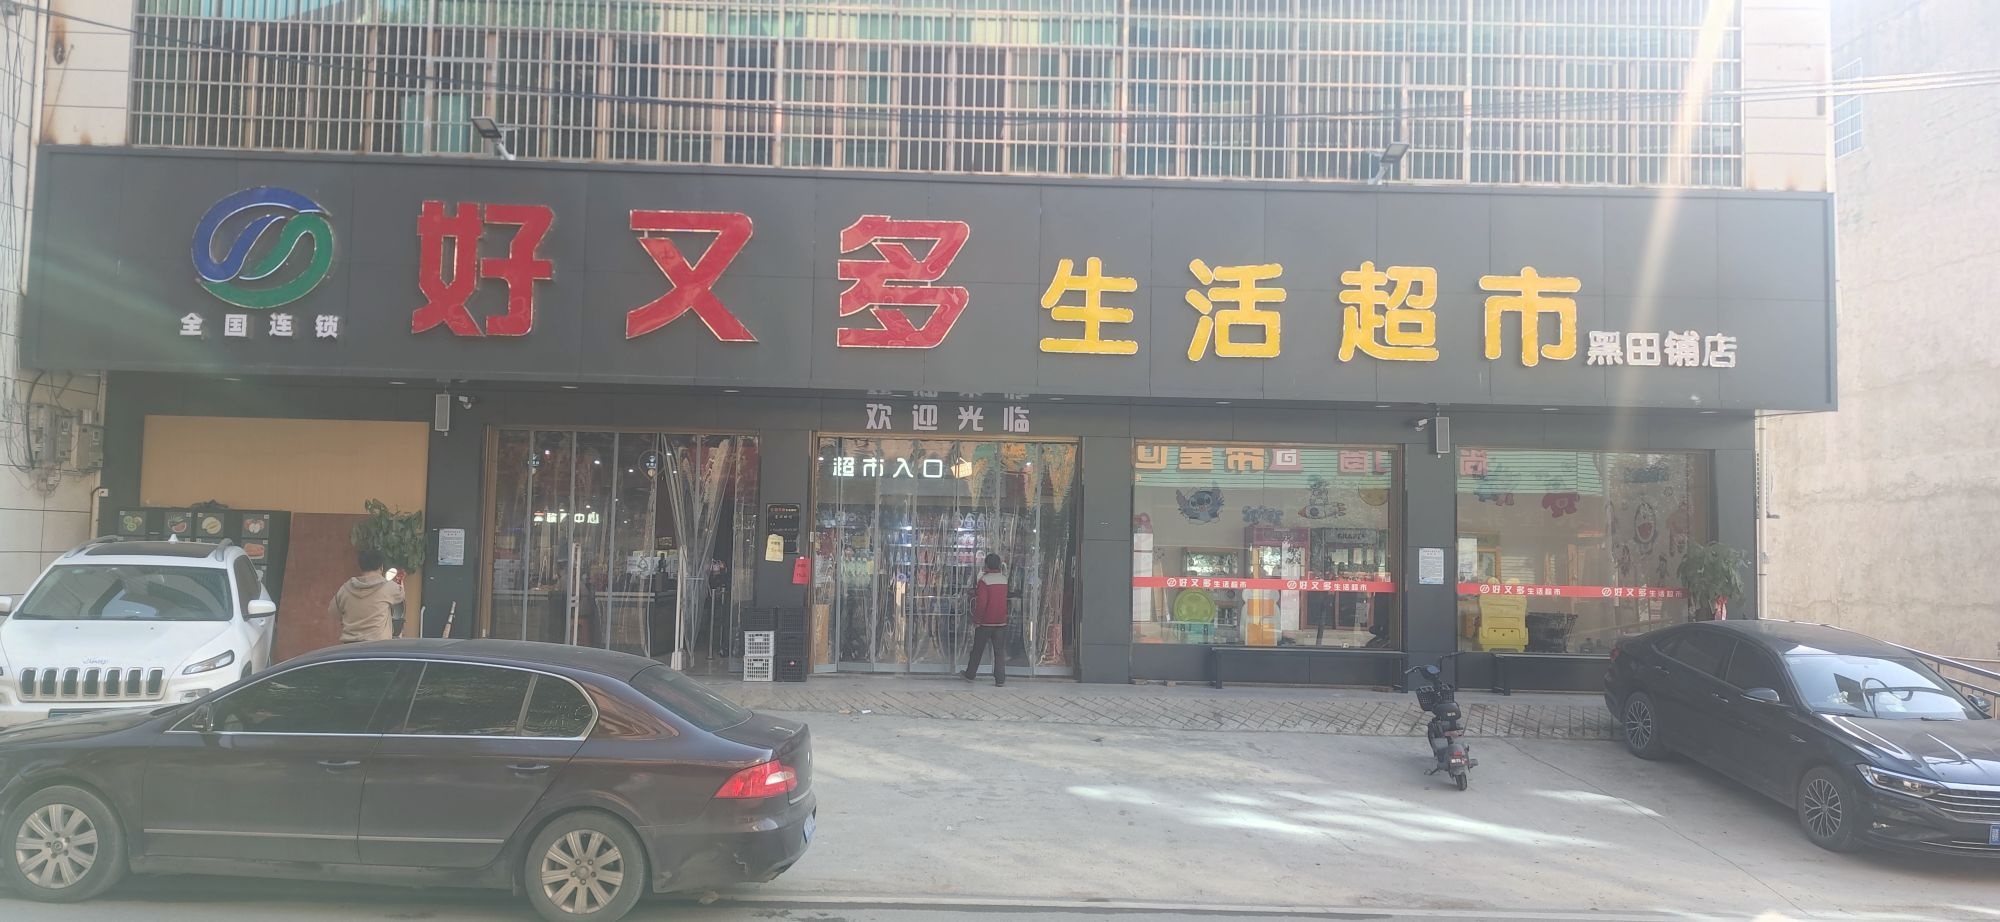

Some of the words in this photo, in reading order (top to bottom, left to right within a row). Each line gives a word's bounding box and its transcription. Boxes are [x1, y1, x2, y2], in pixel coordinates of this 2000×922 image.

[411, 200, 970, 349] 好又多
[1040, 256, 1582, 368] 生活超市
[1586, 330, 1738, 368] 黑田铺店
[179, 312, 339, 338] 全国连锁
[866, 403, 1030, 433] 欢迎光临
[833, 456, 943, 478] 超市入口
